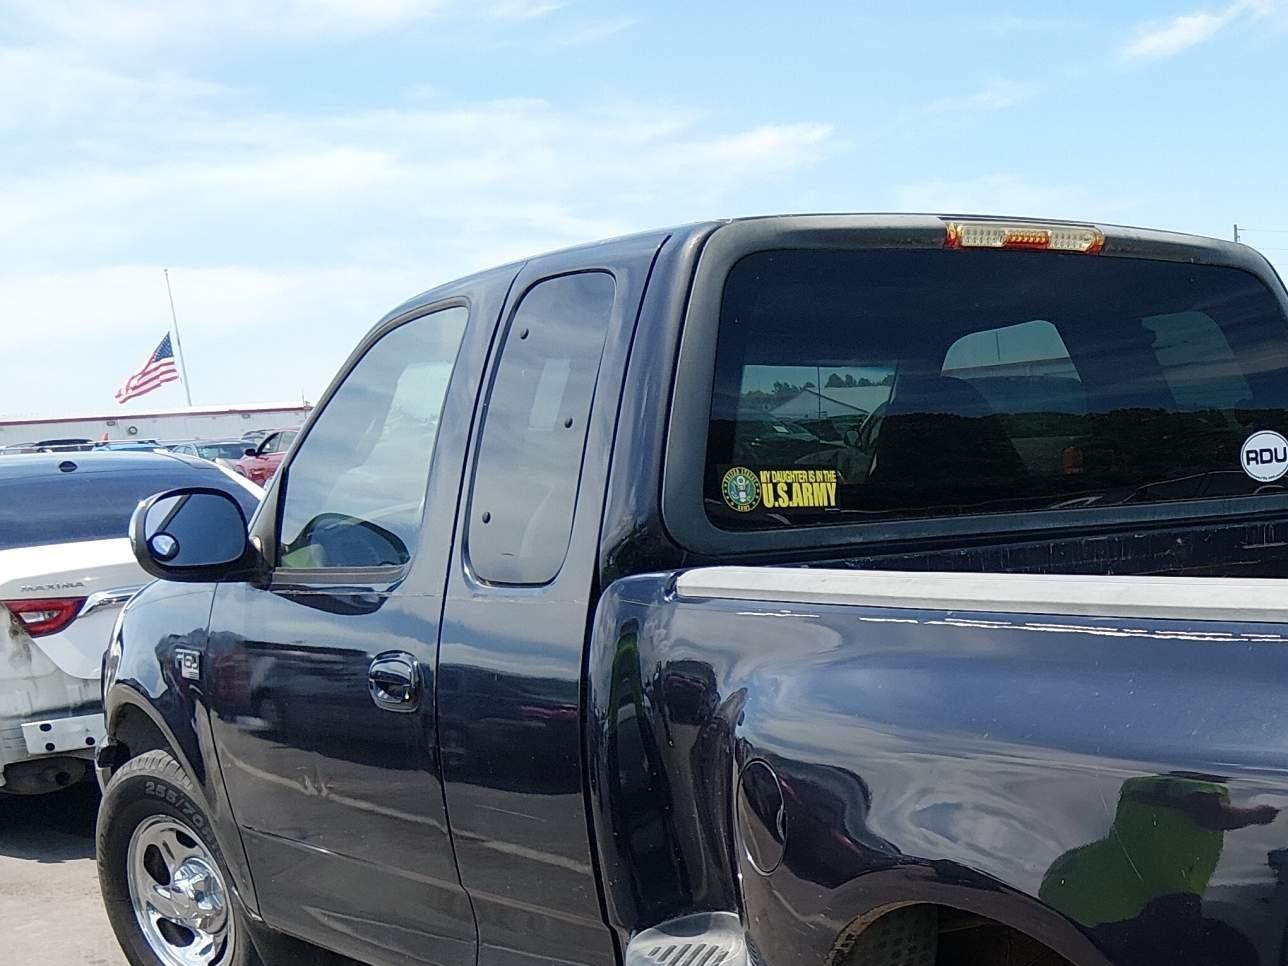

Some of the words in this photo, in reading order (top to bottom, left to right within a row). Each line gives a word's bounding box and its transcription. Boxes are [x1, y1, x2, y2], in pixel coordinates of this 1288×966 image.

[1245, 447, 1287, 465] RDU
[760, 470, 770, 482] MY
[772, 470, 807, 482] DAUGHTER
[807, 470, 815, 482] IS
[823, 470, 837, 482] THE
[20, 581, 85, 592] MAXIMA
